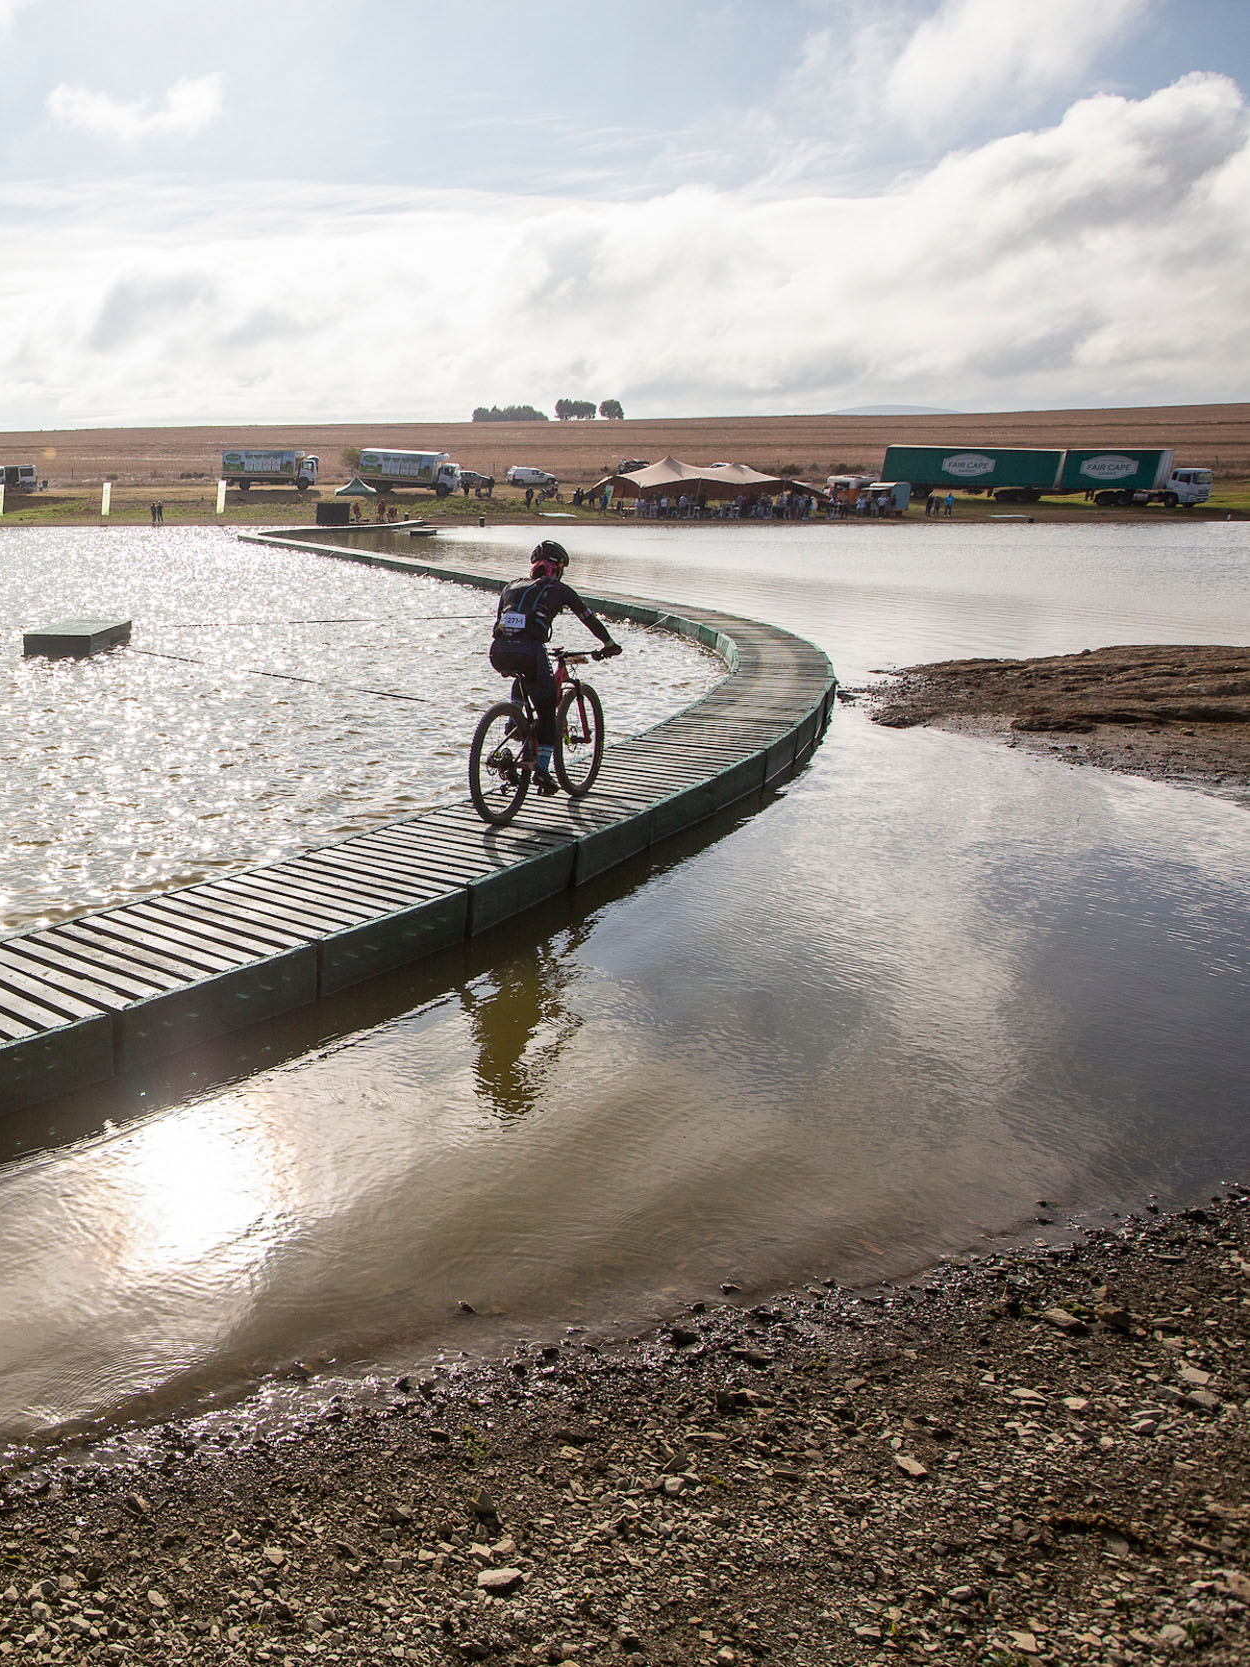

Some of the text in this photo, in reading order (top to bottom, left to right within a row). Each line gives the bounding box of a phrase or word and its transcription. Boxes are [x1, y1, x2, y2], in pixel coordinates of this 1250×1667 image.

[967, 461, 989, 469] CAPE
[1086, 463, 1132, 471] FAIR CAPE
